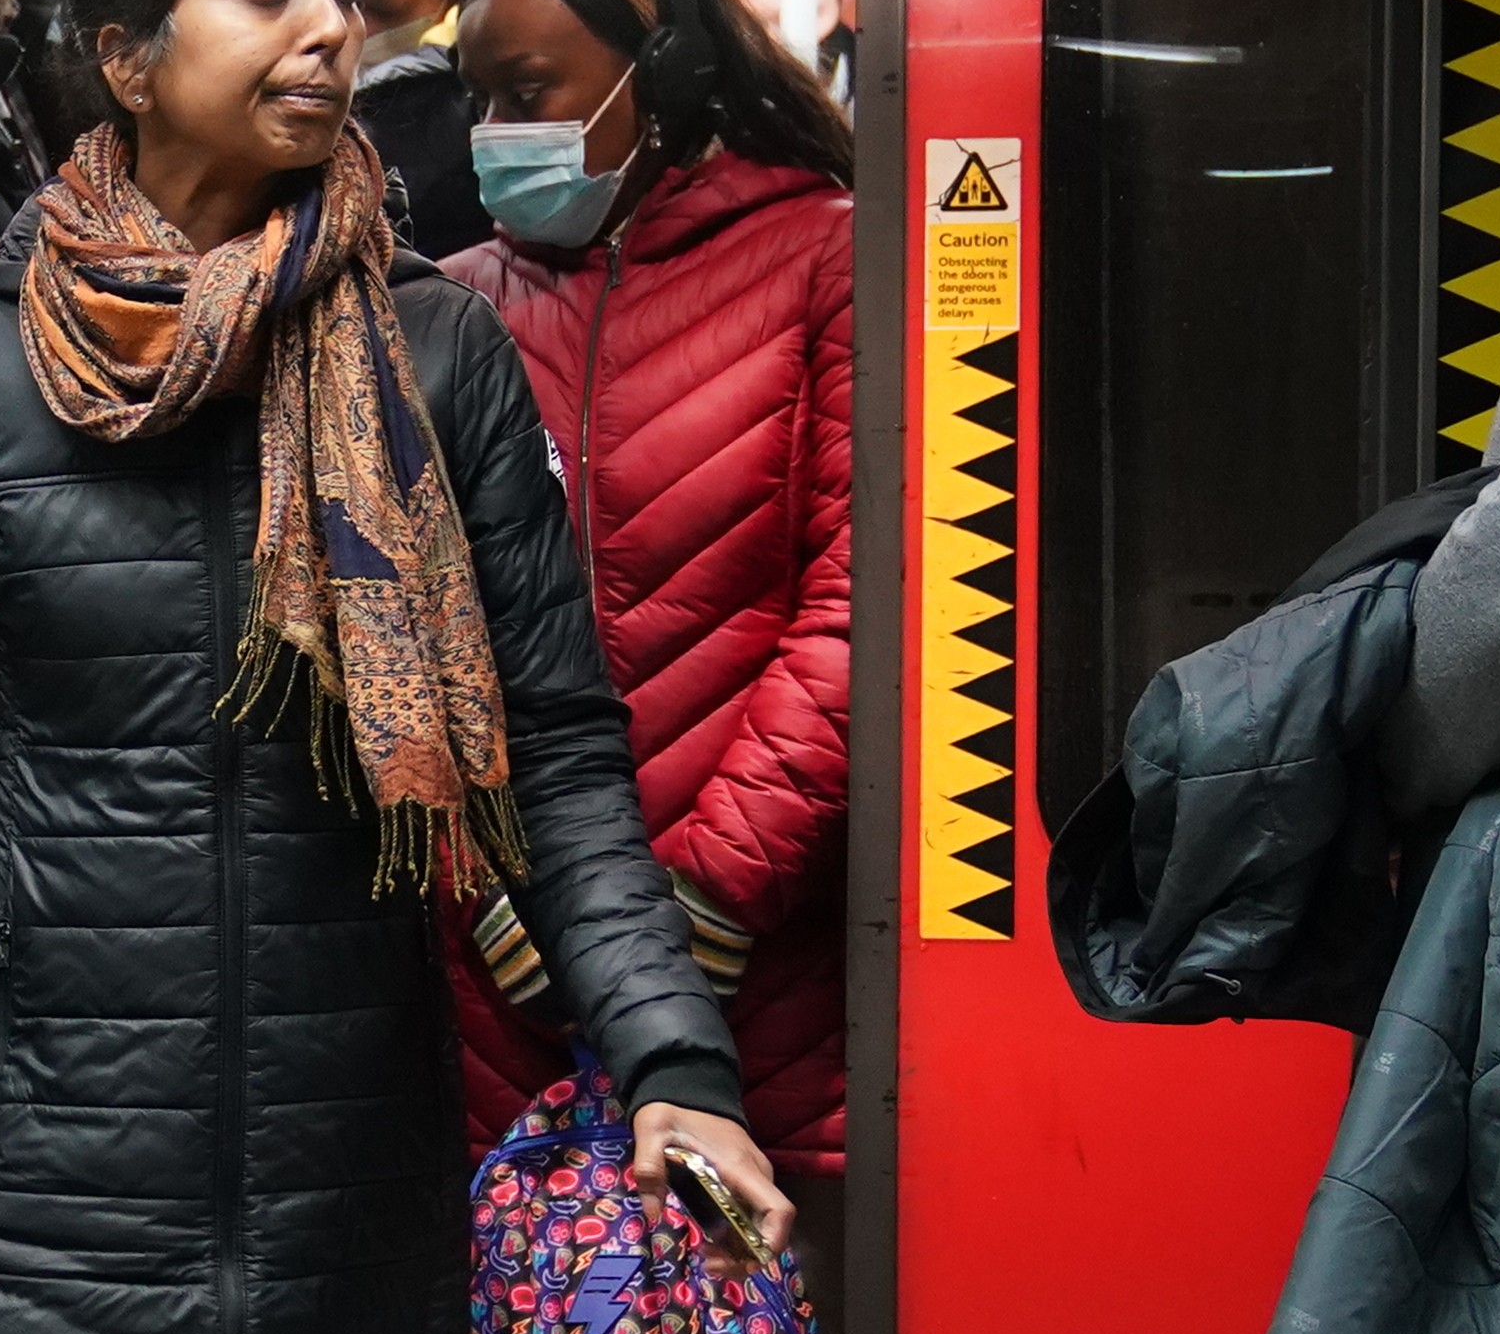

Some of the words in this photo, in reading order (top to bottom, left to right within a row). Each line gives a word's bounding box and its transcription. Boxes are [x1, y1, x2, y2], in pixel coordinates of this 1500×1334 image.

[939, 232, 1008, 247] Caution
[938, 256, 1008, 269] Obstructing
[938, 270, 958, 280] the
[961, 270, 994, 279] doors
[938, 283, 997, 294] dangerous
[938, 296, 958, 305] and
[962, 297, 1001, 305] causes
[938, 308, 974, 320] delays
